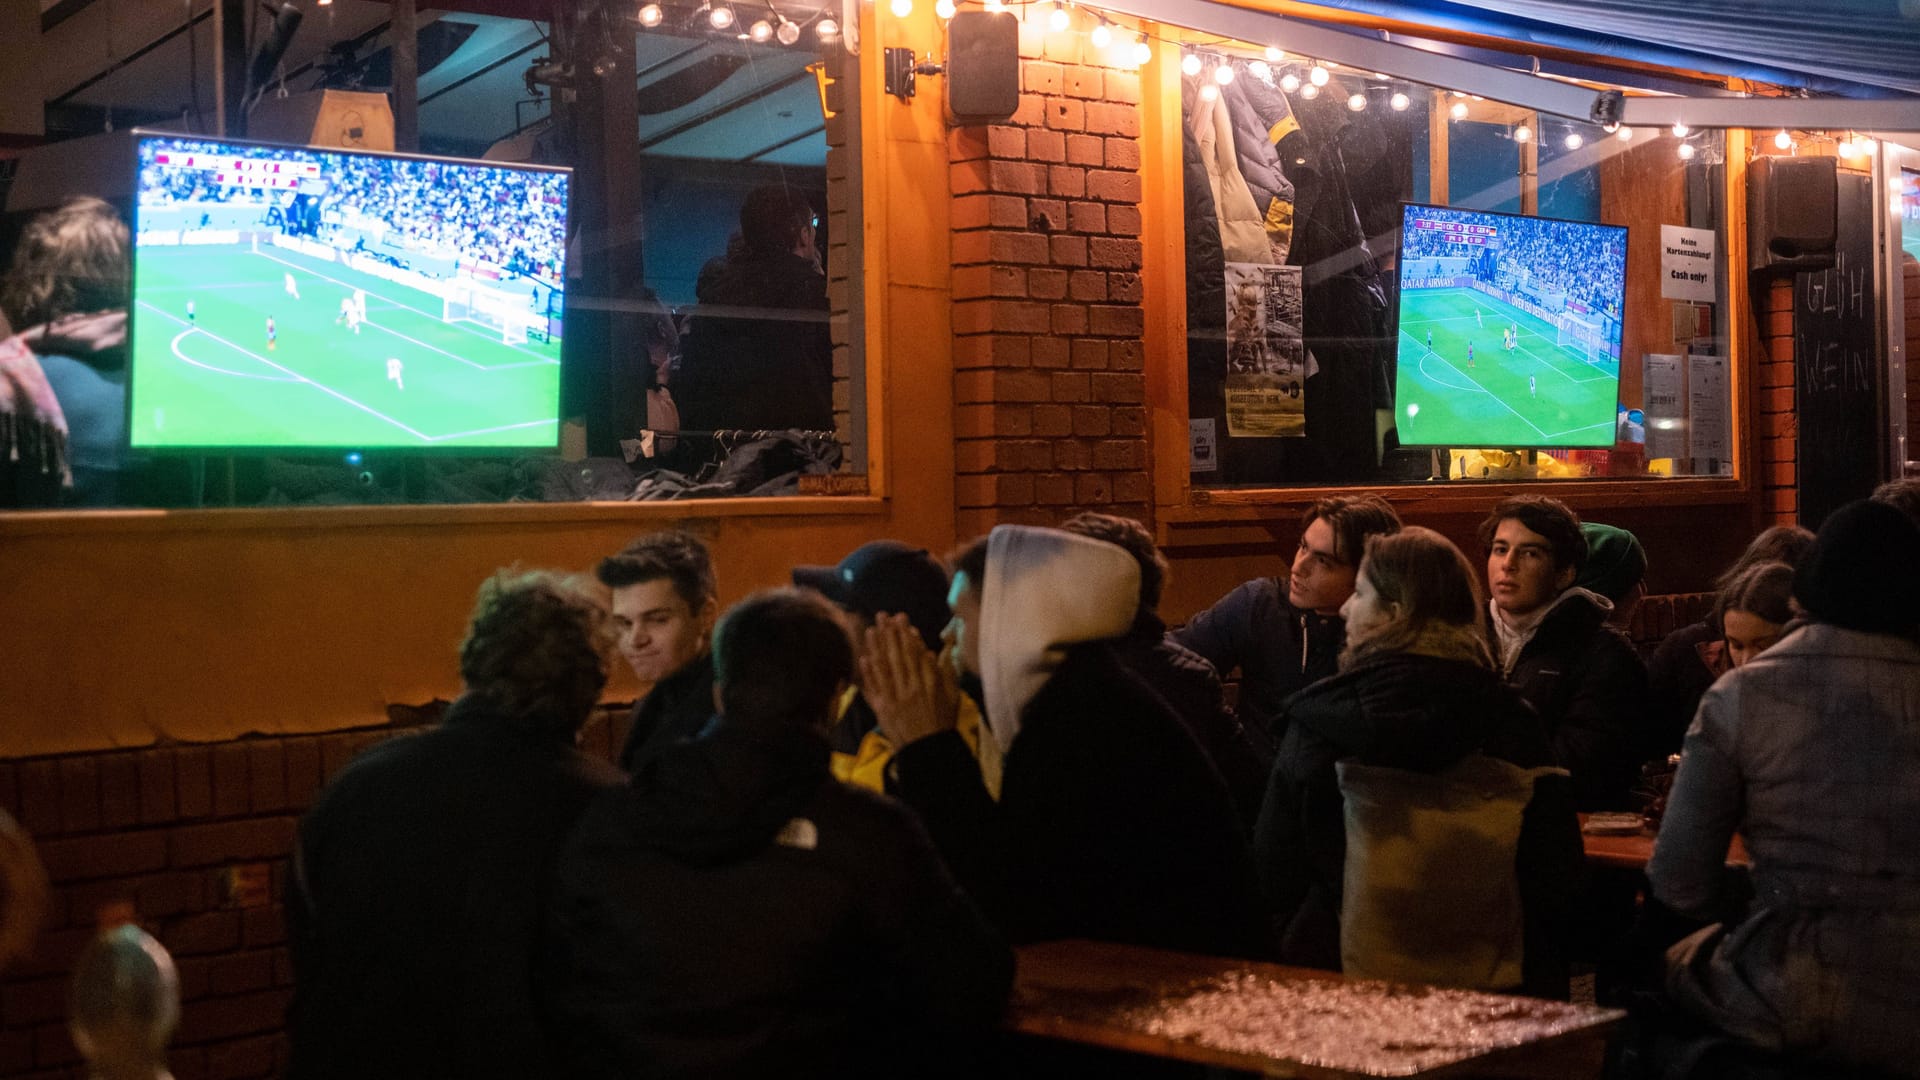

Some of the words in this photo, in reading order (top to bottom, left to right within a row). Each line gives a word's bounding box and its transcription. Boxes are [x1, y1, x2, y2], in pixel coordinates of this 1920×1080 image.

[1681, 237, 1697, 247] Keine
[1666, 247, 1712, 260] Kartenzahlung!
[1671, 269, 1688, 280] Cash
[1690, 272, 1707, 284] only!
[1401, 279, 1424, 289] QATAR
[1427, 279, 1455, 288] AIRWAYS
[1808, 251, 1864, 319] GLÜH
[1801, 333, 1869, 394] WEIN
